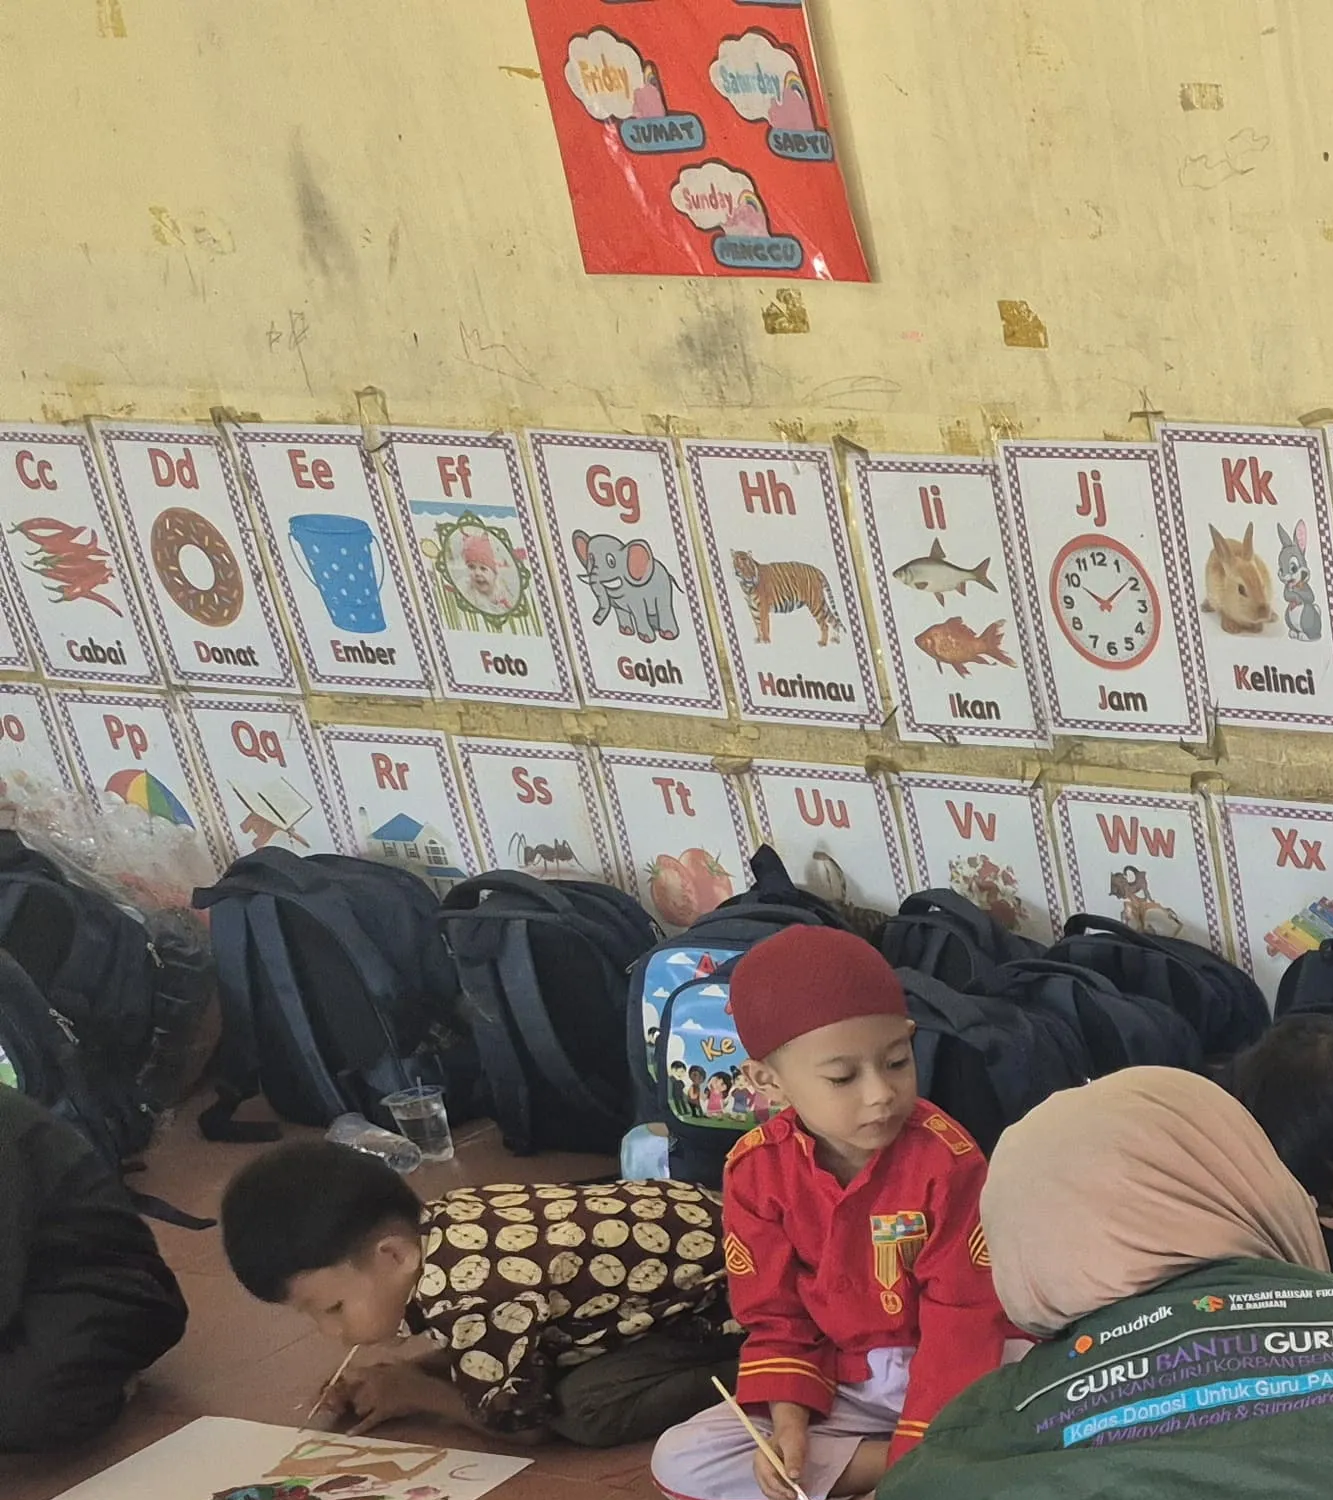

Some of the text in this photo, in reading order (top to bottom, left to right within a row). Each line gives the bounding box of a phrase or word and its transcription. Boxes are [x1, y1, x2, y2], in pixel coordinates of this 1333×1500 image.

[578, 54, 631, 99] Friday
[720, 63, 780, 104] Saturday
[630, 121, 695, 143] JUMAT
[773, 132, 830, 154] SABTU
[683, 184, 734, 218] Sunday
[15, 450, 57, 491] Cc
[149, 448, 198, 490] Dd
[288, 449, 334, 491] Ee
[436, 455, 471, 498] Ff
[1221, 455, 1278, 505] Kk
[585, 465, 640, 523] Gg
[739, 470, 796, 516] Hh
[1076, 470, 1107, 526] Jj
[1076, 558, 1088, 571] 11
[1090, 552, 1107, 566] 12
[1114, 560, 1121, 573] 1
[1065, 573, 1081, 588] 10
[1128, 577, 1140, 591] 2
[1063, 595, 1075, 609] 9
[1137, 600, 1148, 613] 3
[1072, 616, 1083, 631] 8
[1135, 621, 1146, 635] 4
[66, 638, 127, 666] Cabai
[194, 641, 258, 668] Donat
[331, 640, 396, 667] Ember
[1088, 635, 1099, 648] 7
[1107, 641, 1118, 656] 6
[1124, 637, 1135, 651] 5
[481, 651, 528, 677] Foto
[617, 656, 683, 687] Gajah
[1234, 664, 1315, 695] Kelinci
[758, 672, 855, 703] Harimau
[1098, 685, 1147, 713] Jam
[949, 694, 1001, 720] Ikan
[0, 714, 25, 742] o
[104, 714, 148, 759] Pp
[230, 720, 286, 766] Qq
[371, 753, 409, 792] Rr
[511, 766, 553, 806] Ss
[652, 777, 695, 817] Tt
[794, 787, 850, 828] Uu
[945, 799, 996, 841] Vv
[1096, 812, 1175, 859] Ww
[1271, 826, 1326, 872] Xx
[1228, 1290, 1273, 1302] YAYASAN
[1100, 1304, 1174, 1344] paudtalk
[1067, 1357, 1149, 1402] GURU
[1157, 1334, 1259, 1371] BANTU
[1158, 1361, 1211, 1387] GURU
[1213, 1354, 1296, 1373] KORBAN
[1070, 1414, 1120, 1442] Kelas
[1123, 1393, 1187, 1425] Donasi
[1196, 1383, 1248, 1407] Untuk
[1255, 1377, 1299, 1397] Guru
